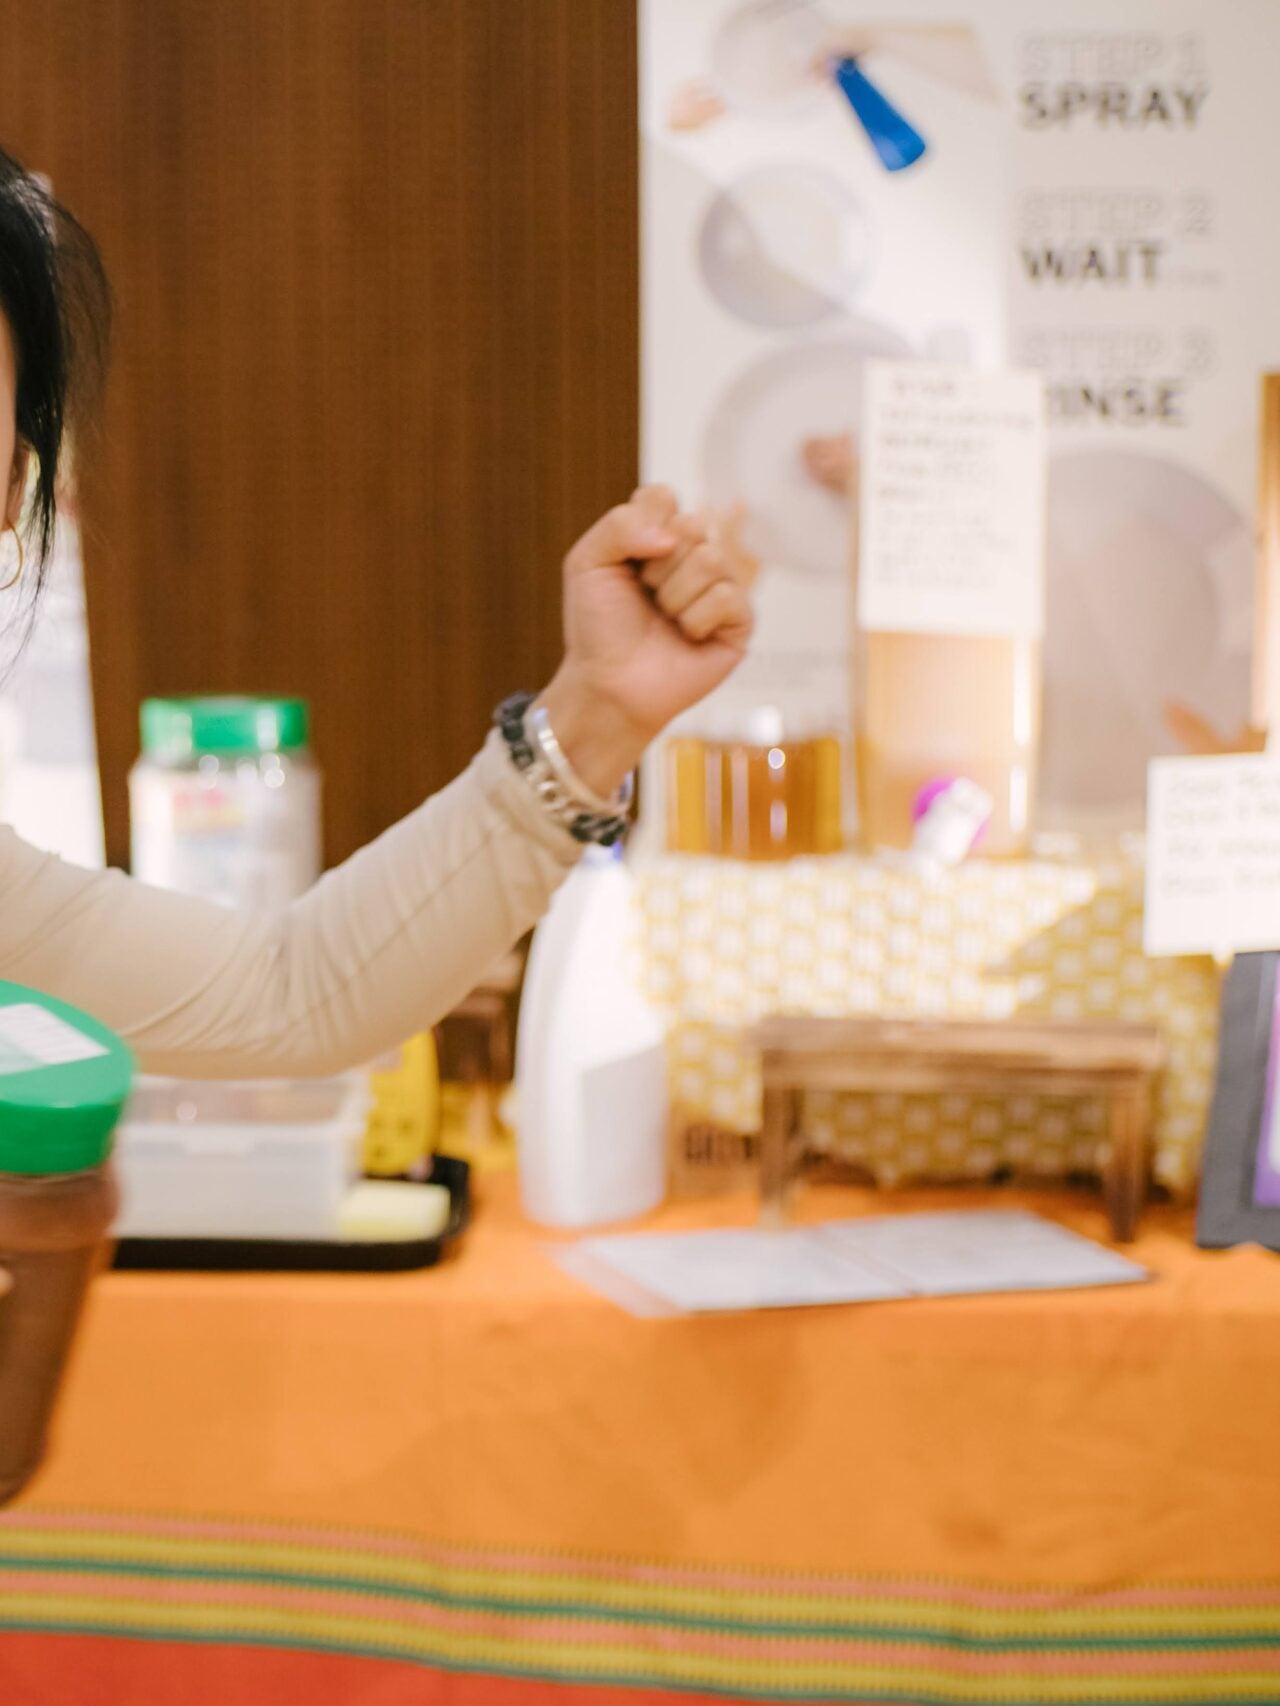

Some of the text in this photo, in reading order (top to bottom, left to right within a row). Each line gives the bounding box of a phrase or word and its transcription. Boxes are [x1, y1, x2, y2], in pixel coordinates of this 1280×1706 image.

[1021, 31, 1207, 78] STEP 1
[1021, 83, 1208, 128] SPRAY
[1021, 188, 1214, 236] STEP 2
[1021, 241, 1163, 287] WAIT
[1020, 327, 1161, 372] STEP
[1040, 379, 1188, 427] INSE
